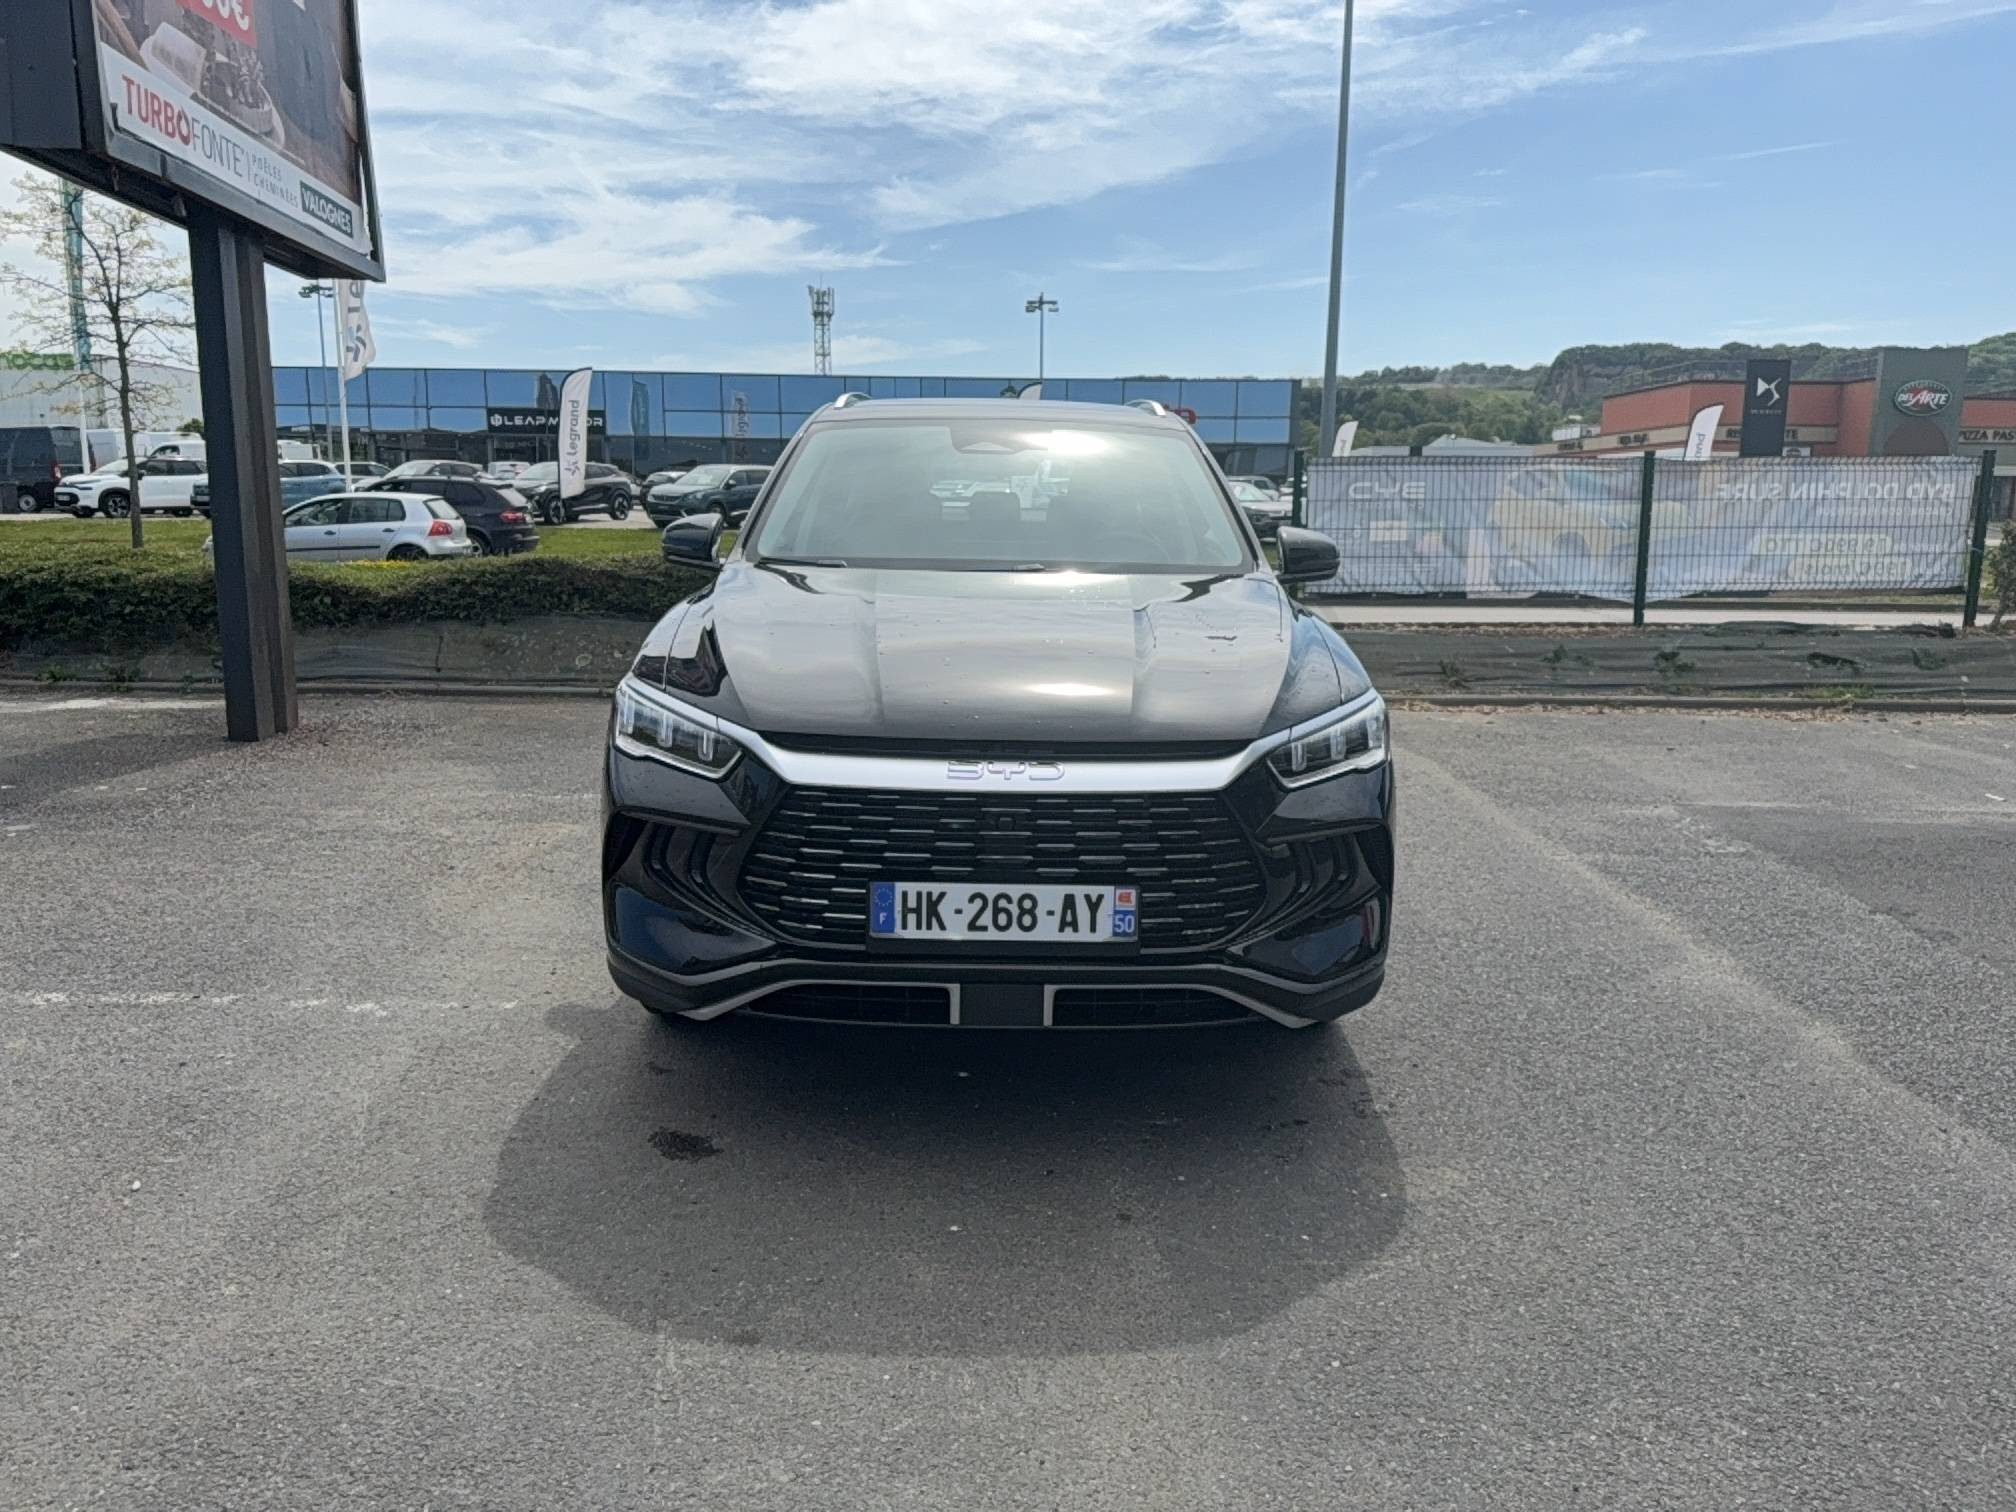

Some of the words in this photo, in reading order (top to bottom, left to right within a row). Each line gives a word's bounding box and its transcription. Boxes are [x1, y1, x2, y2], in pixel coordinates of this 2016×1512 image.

[302, 187, 352, 234] VALOGNES
[1993, 430, 2016, 441] PAS
[947, 760, 1065, 780] BYD
[878, 912, 887, 926] F
[900, 890, 1105, 933] HK-268-AY
[1113, 914, 1135, 933] 50
